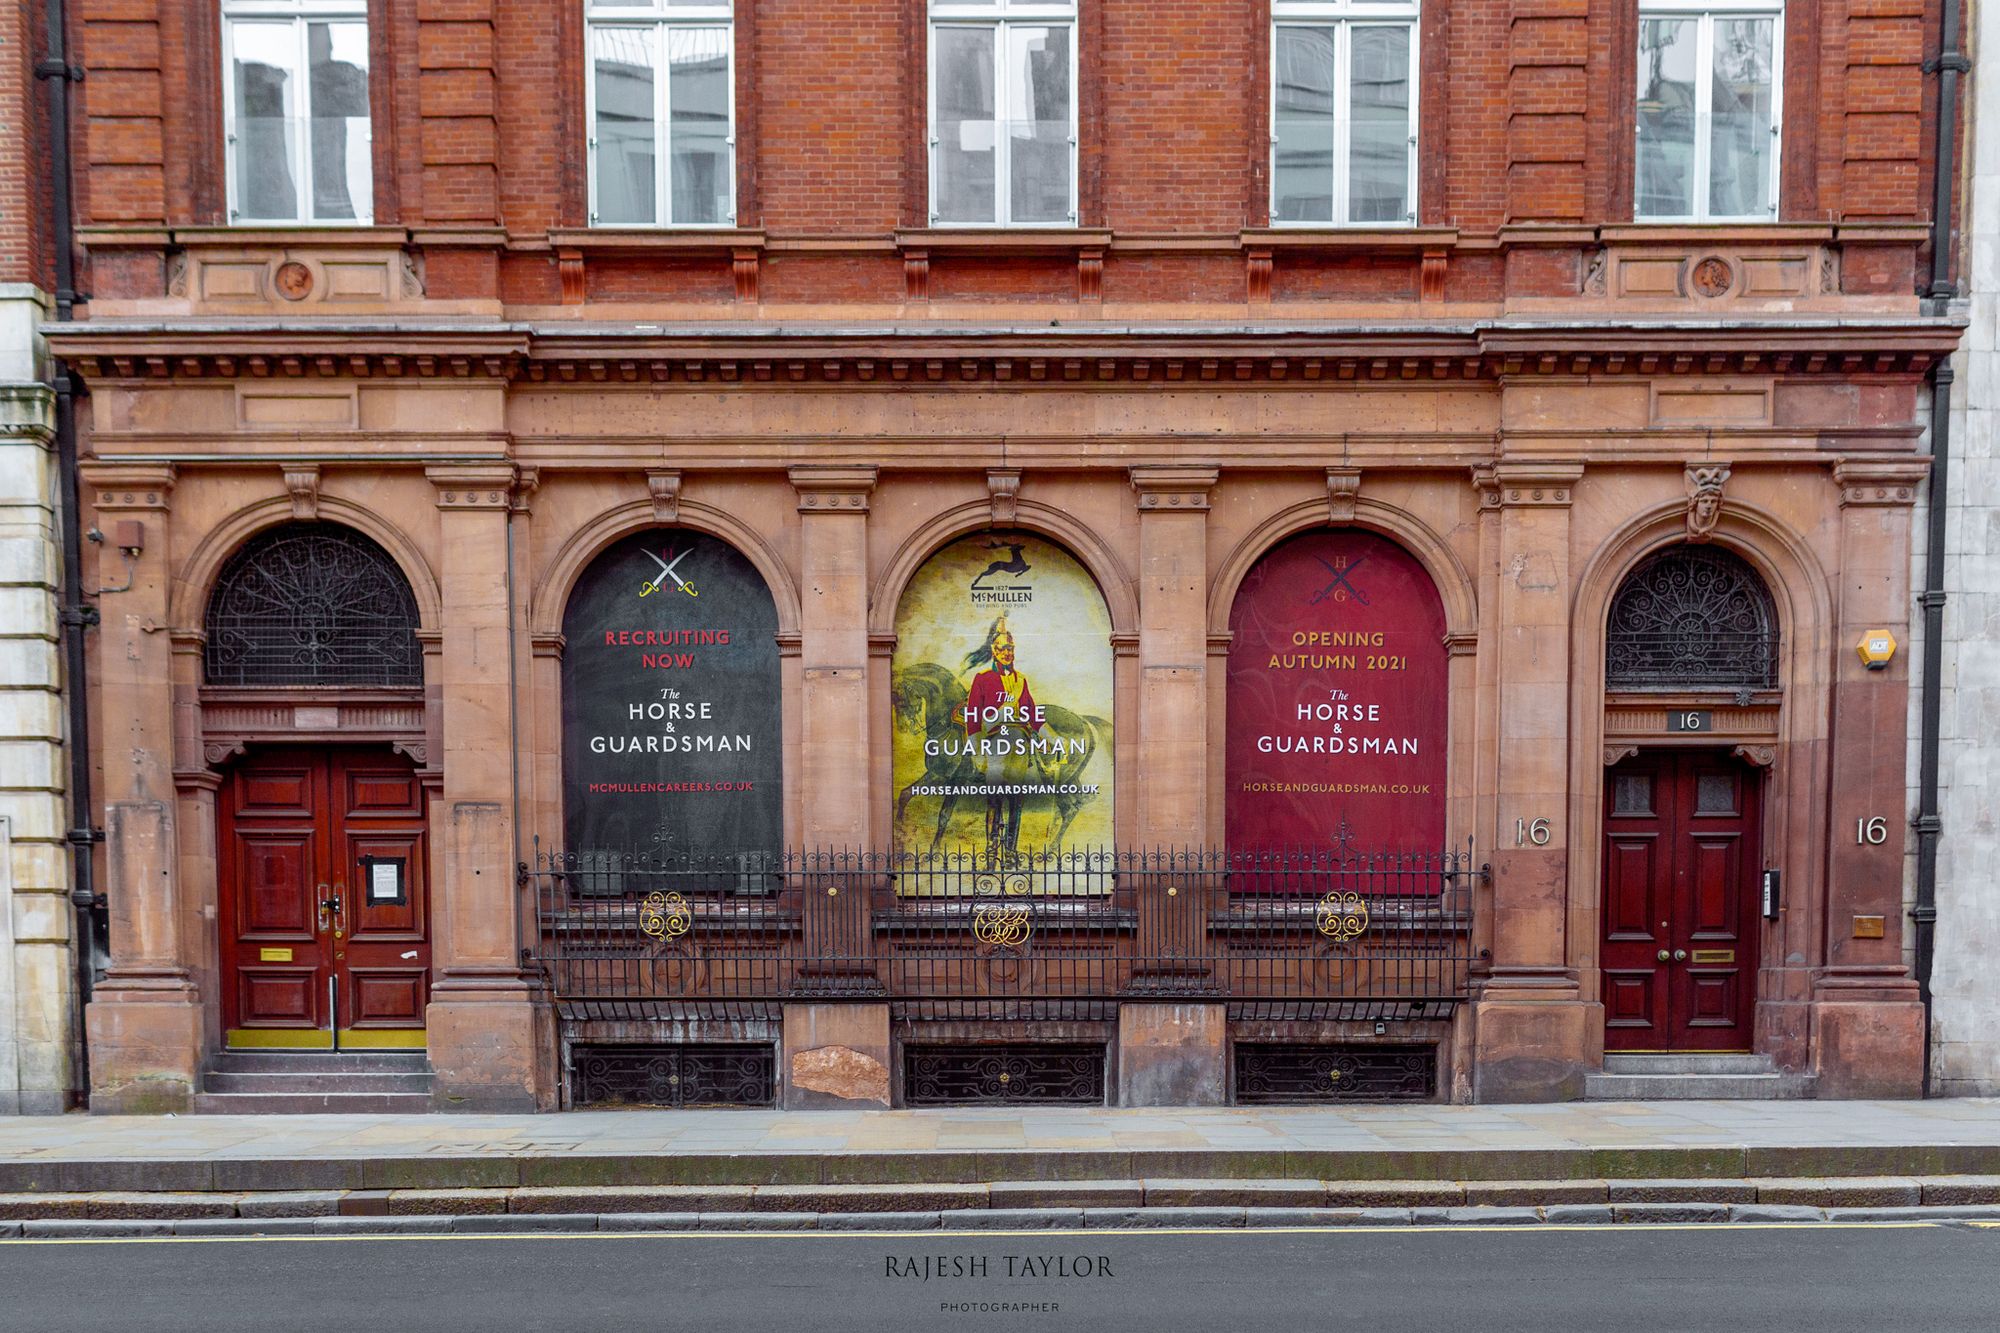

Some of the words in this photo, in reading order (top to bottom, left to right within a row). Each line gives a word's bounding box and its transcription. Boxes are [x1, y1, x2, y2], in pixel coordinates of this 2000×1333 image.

[1335, 555, 1347, 568] H
[1334, 589, 1346, 602] G
[605, 629, 731, 645] RECRUITING
[1292, 631, 1385, 647] OPENING
[642, 653, 695, 669] NOW
[1268, 655, 1357, 670] AUTUMN
[1366, 655, 1407, 670] 2021
[660, 688, 681, 700] The
[995, 691, 1015, 703] The
[1329, 689, 1349, 701] The
[629, 703, 712, 720] HORSE
[963, 705, 1046, 723] HORSE
[1297, 704, 1380, 721] HORSE
[666, 722, 676, 733] &
[1680, 712, 1700, 729] 16
[1000, 724, 1010, 736] &
[1333, 723, 1343, 734] &
[590, 734, 752, 753] GUARDSMAN
[924, 738, 1087, 757] GUARDSMAN
[1257, 736, 1418, 755] GUARDSMAN
[589, 782, 754, 793] MCMULLENCAREERS.CO.UK
[911, 784, 1099, 796] HORSEANDGUARDSMAN.CO.UK
[1243, 782, 1431, 794] HORSEANDGUARDSMAN.CO.UK
[1516, 817, 1551, 845] 16
[1857, 816, 1887, 845] 16
